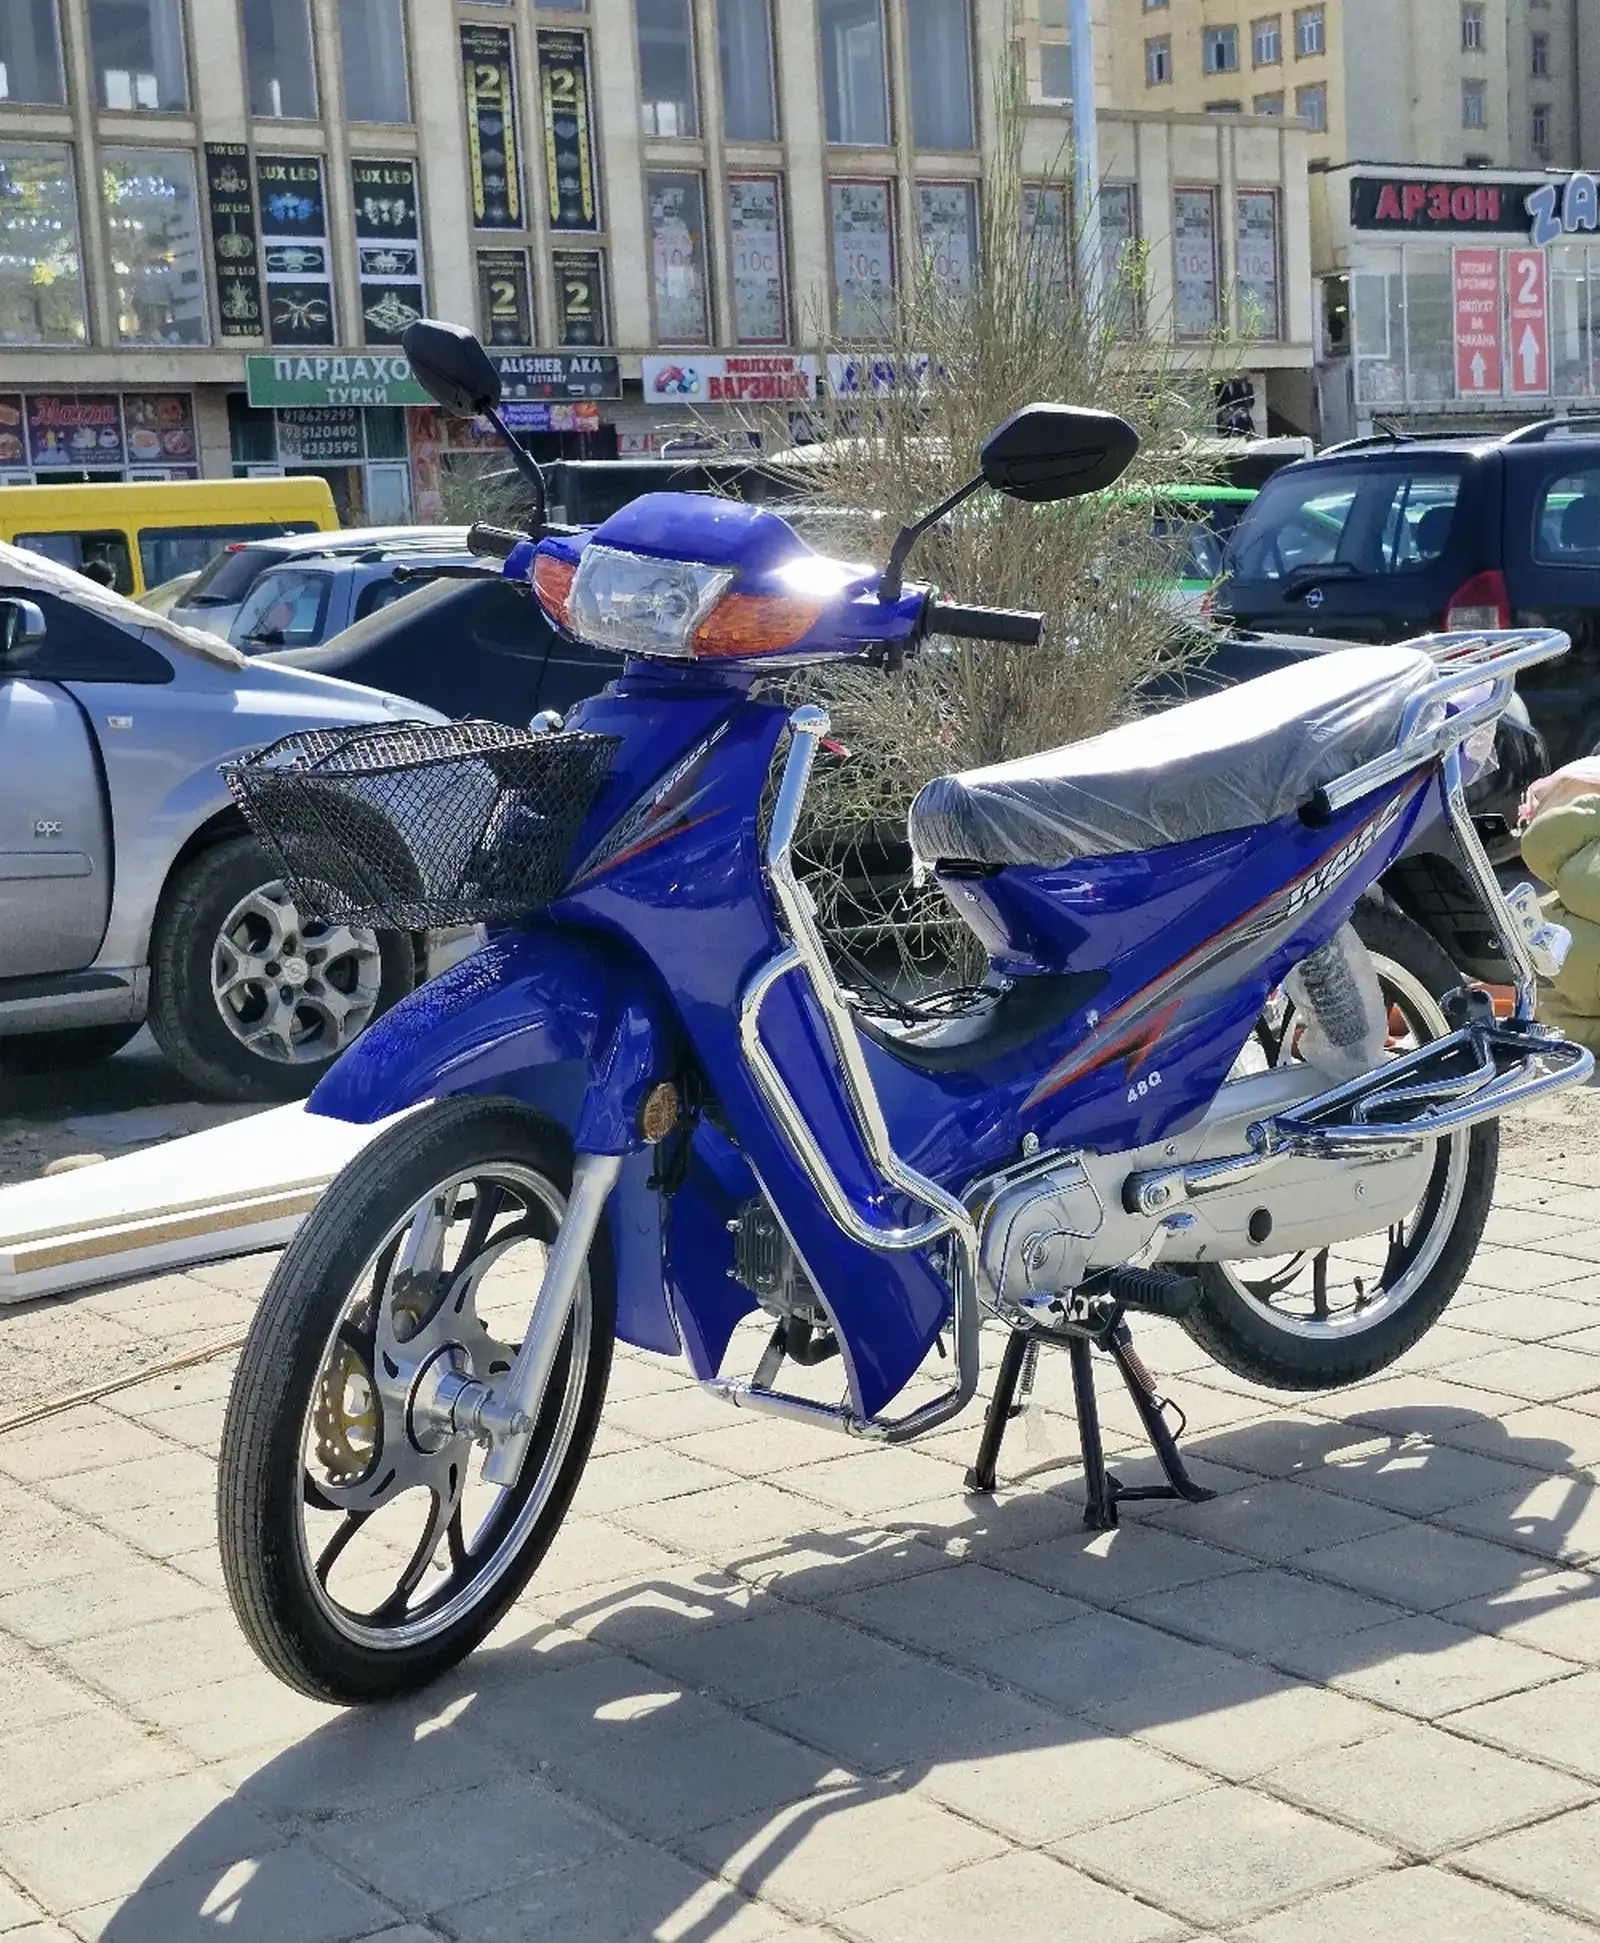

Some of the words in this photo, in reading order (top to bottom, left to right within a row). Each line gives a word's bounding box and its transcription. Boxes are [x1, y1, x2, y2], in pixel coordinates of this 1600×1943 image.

[476, 64, 501, 98] 2
[551, 67, 576, 102] 2
[259, 165, 286, 181] LUX
[289, 167, 319, 181] LED
[354, 168, 381, 184] LUX
[383, 170, 412, 184] LED
[1375, 184, 1499, 221] АРЗОН
[1524, 173, 1600, 249] ZA
[490, 280, 517, 314] 2
[565, 280, 591, 314] 2
[1517, 258, 1539, 304] 2
[274, 357, 418, 384] ПАРДАҲО
[500, 357, 562, 373] ALISHER
[570, 358, 603, 373] AKA
